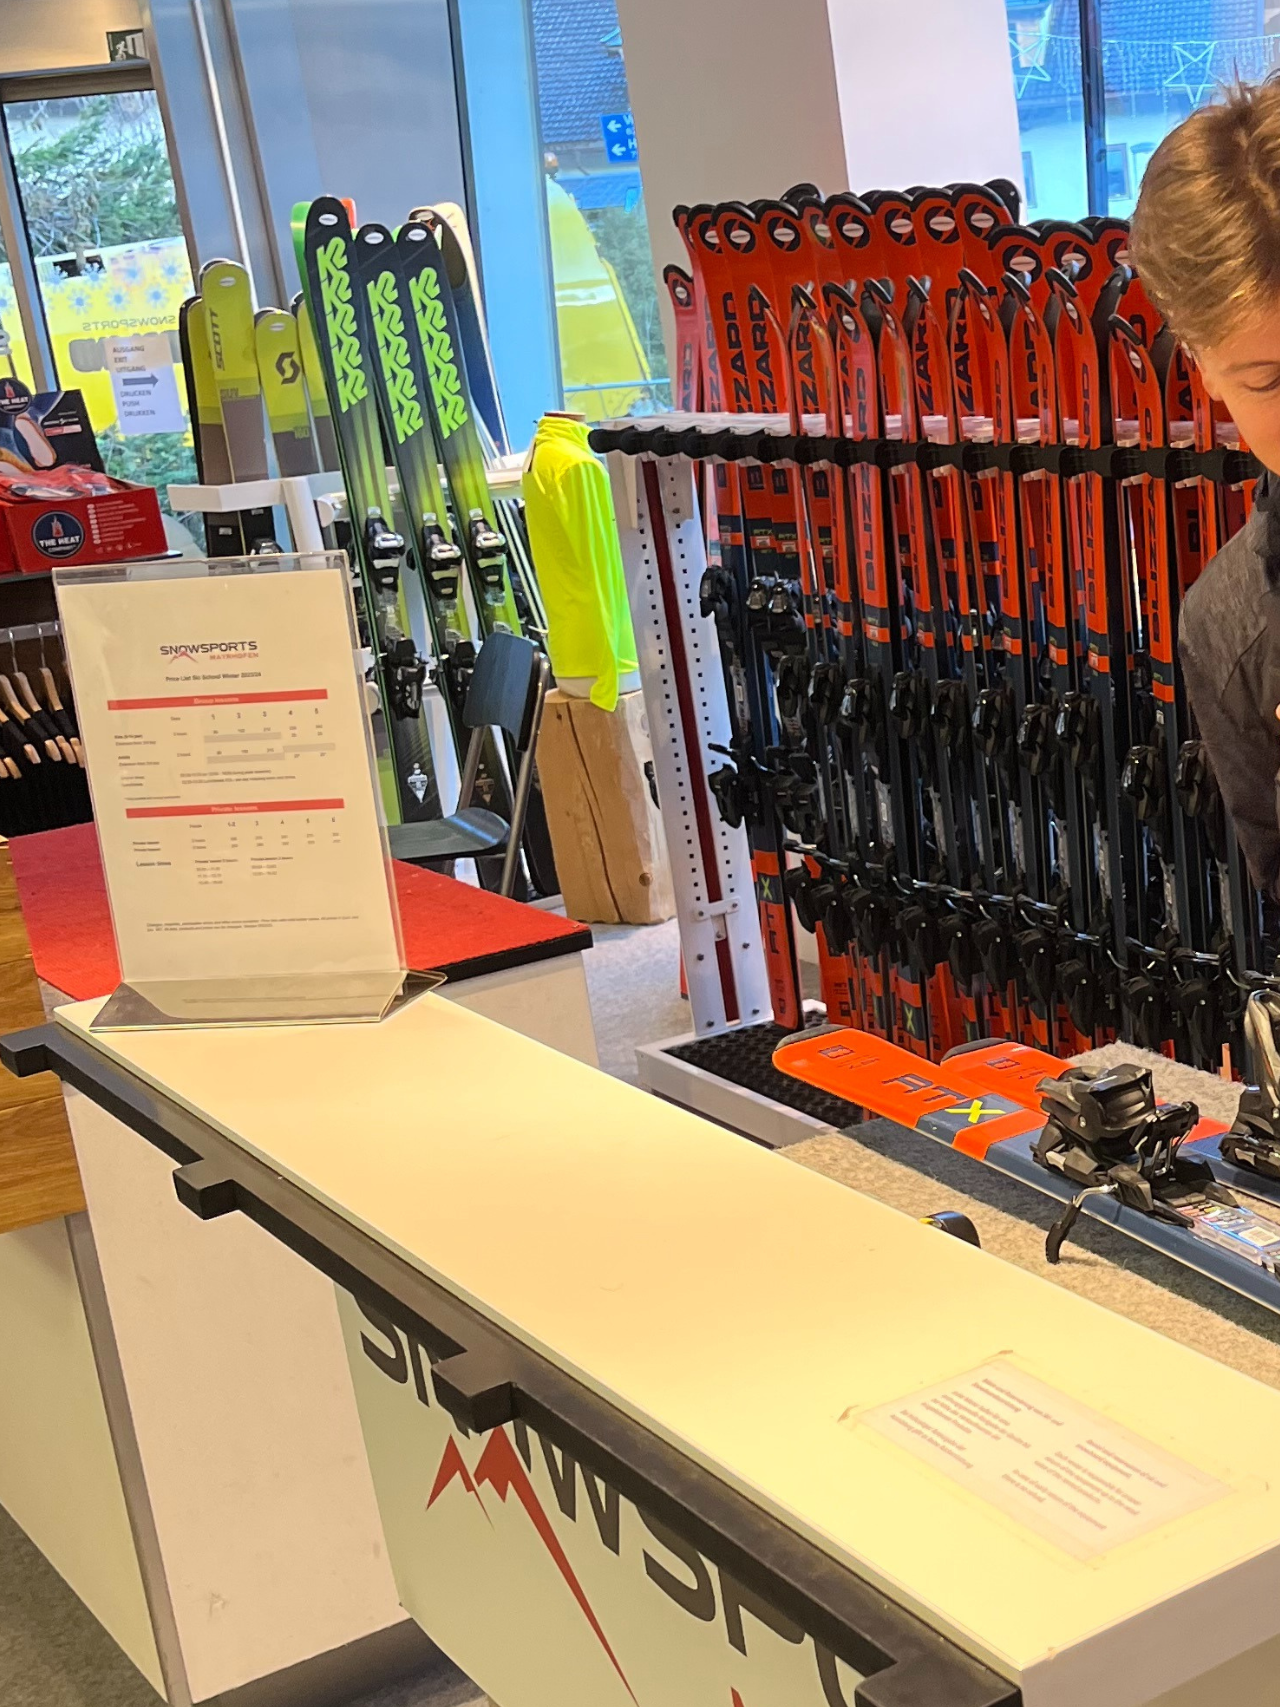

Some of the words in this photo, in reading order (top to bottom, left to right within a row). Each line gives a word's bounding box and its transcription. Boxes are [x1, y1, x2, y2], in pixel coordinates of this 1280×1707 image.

[209, 307, 225, 371] SCOTT
[113, 345, 145, 353] AUSGANG
[114, 356, 127, 364] EXIT
[116, 365, 146, 373] UITGANG
[120, 390, 152, 398] DRUCKEN
[124, 409, 156, 417] DRUKKEN
[40, 538, 56, 547] THE
[58, 535, 80, 544] HEAT
[160, 641, 258, 655] SNOWSPORTS
[209, 652, 259, 660] MAYRHOFEN
[881, 1073, 1006, 1124] ATX
